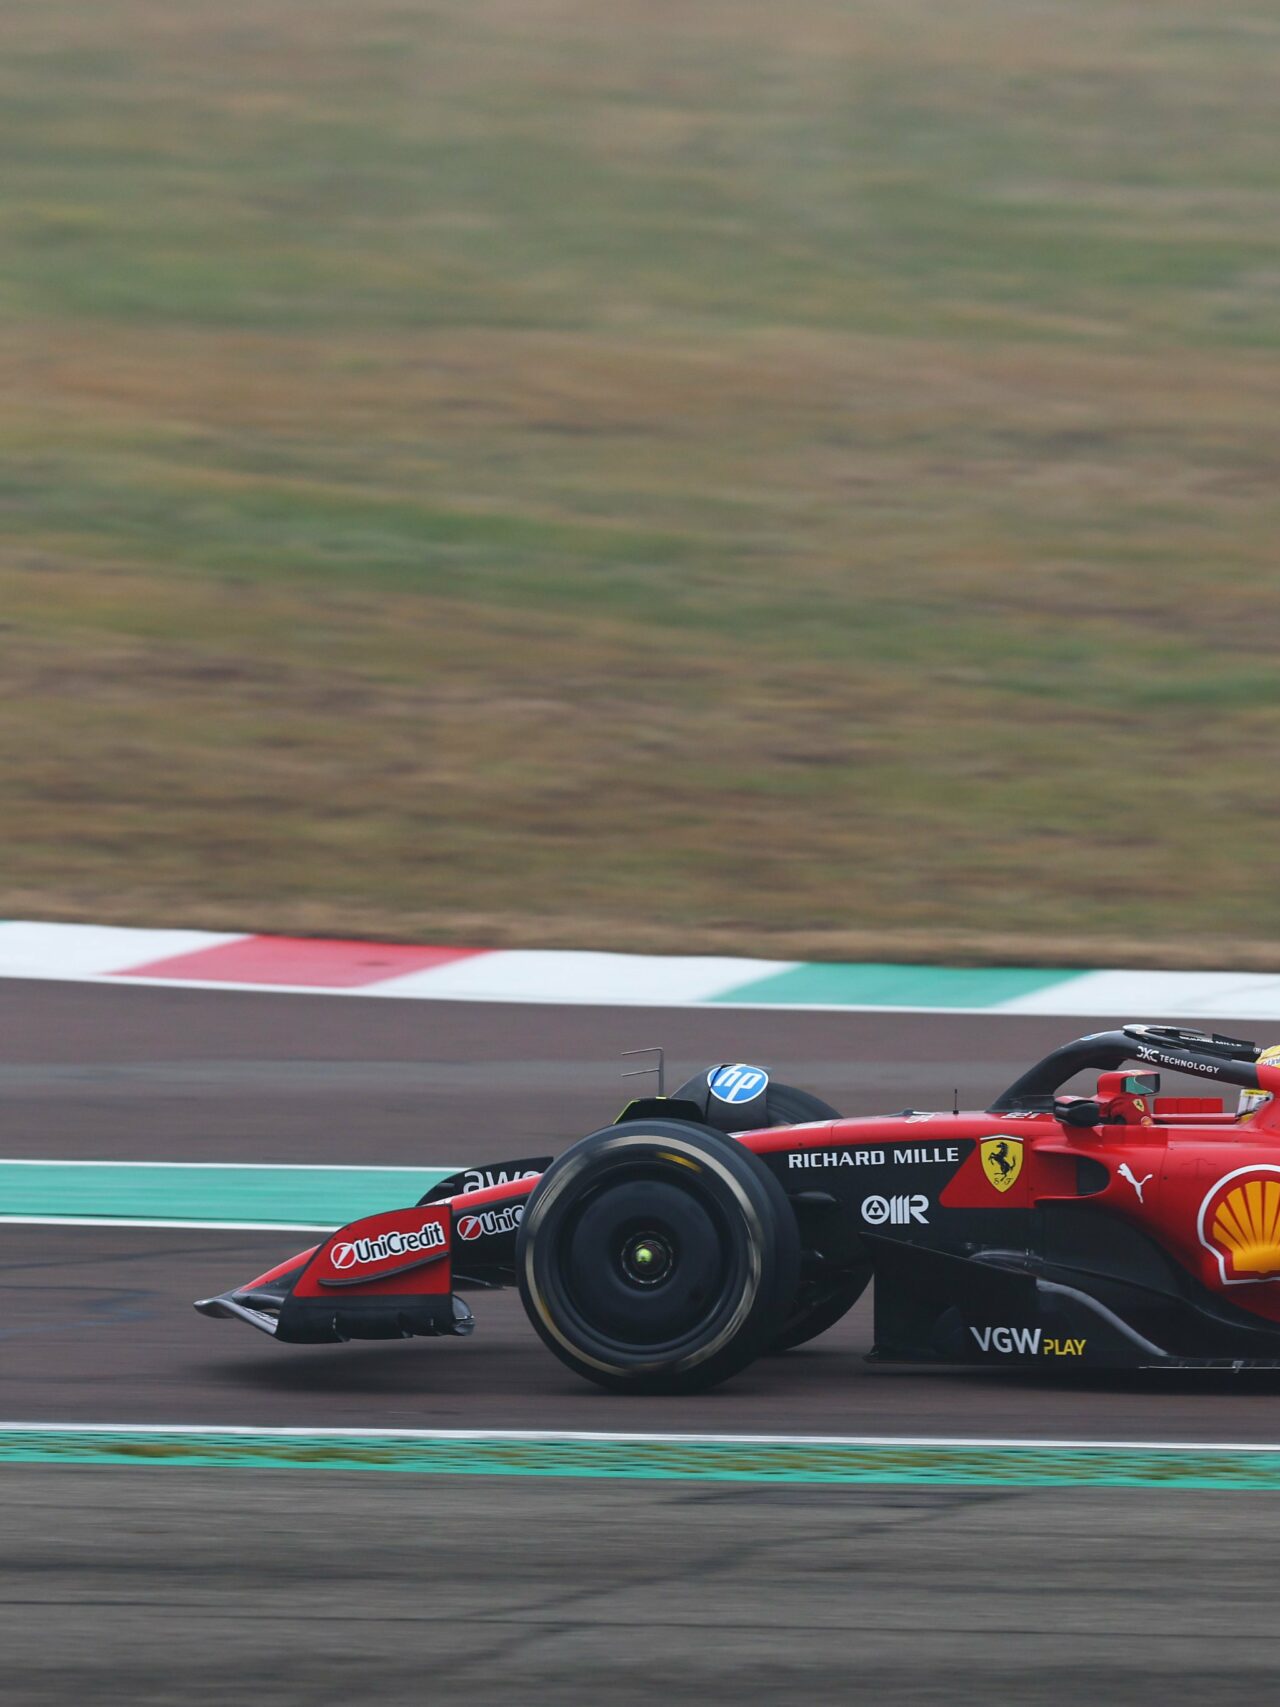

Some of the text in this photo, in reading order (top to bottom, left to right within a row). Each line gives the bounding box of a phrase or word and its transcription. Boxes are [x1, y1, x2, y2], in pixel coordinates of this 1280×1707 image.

[1160, 1055, 1220, 1074] TECHNOLOGY
[714, 1065, 762, 1102] hp
[788, 1147, 960, 1169] RICHARD MILLE
[354, 1221, 445, 1264] UniCredit
[969, 1326, 1087, 1356] VGW PLAY
